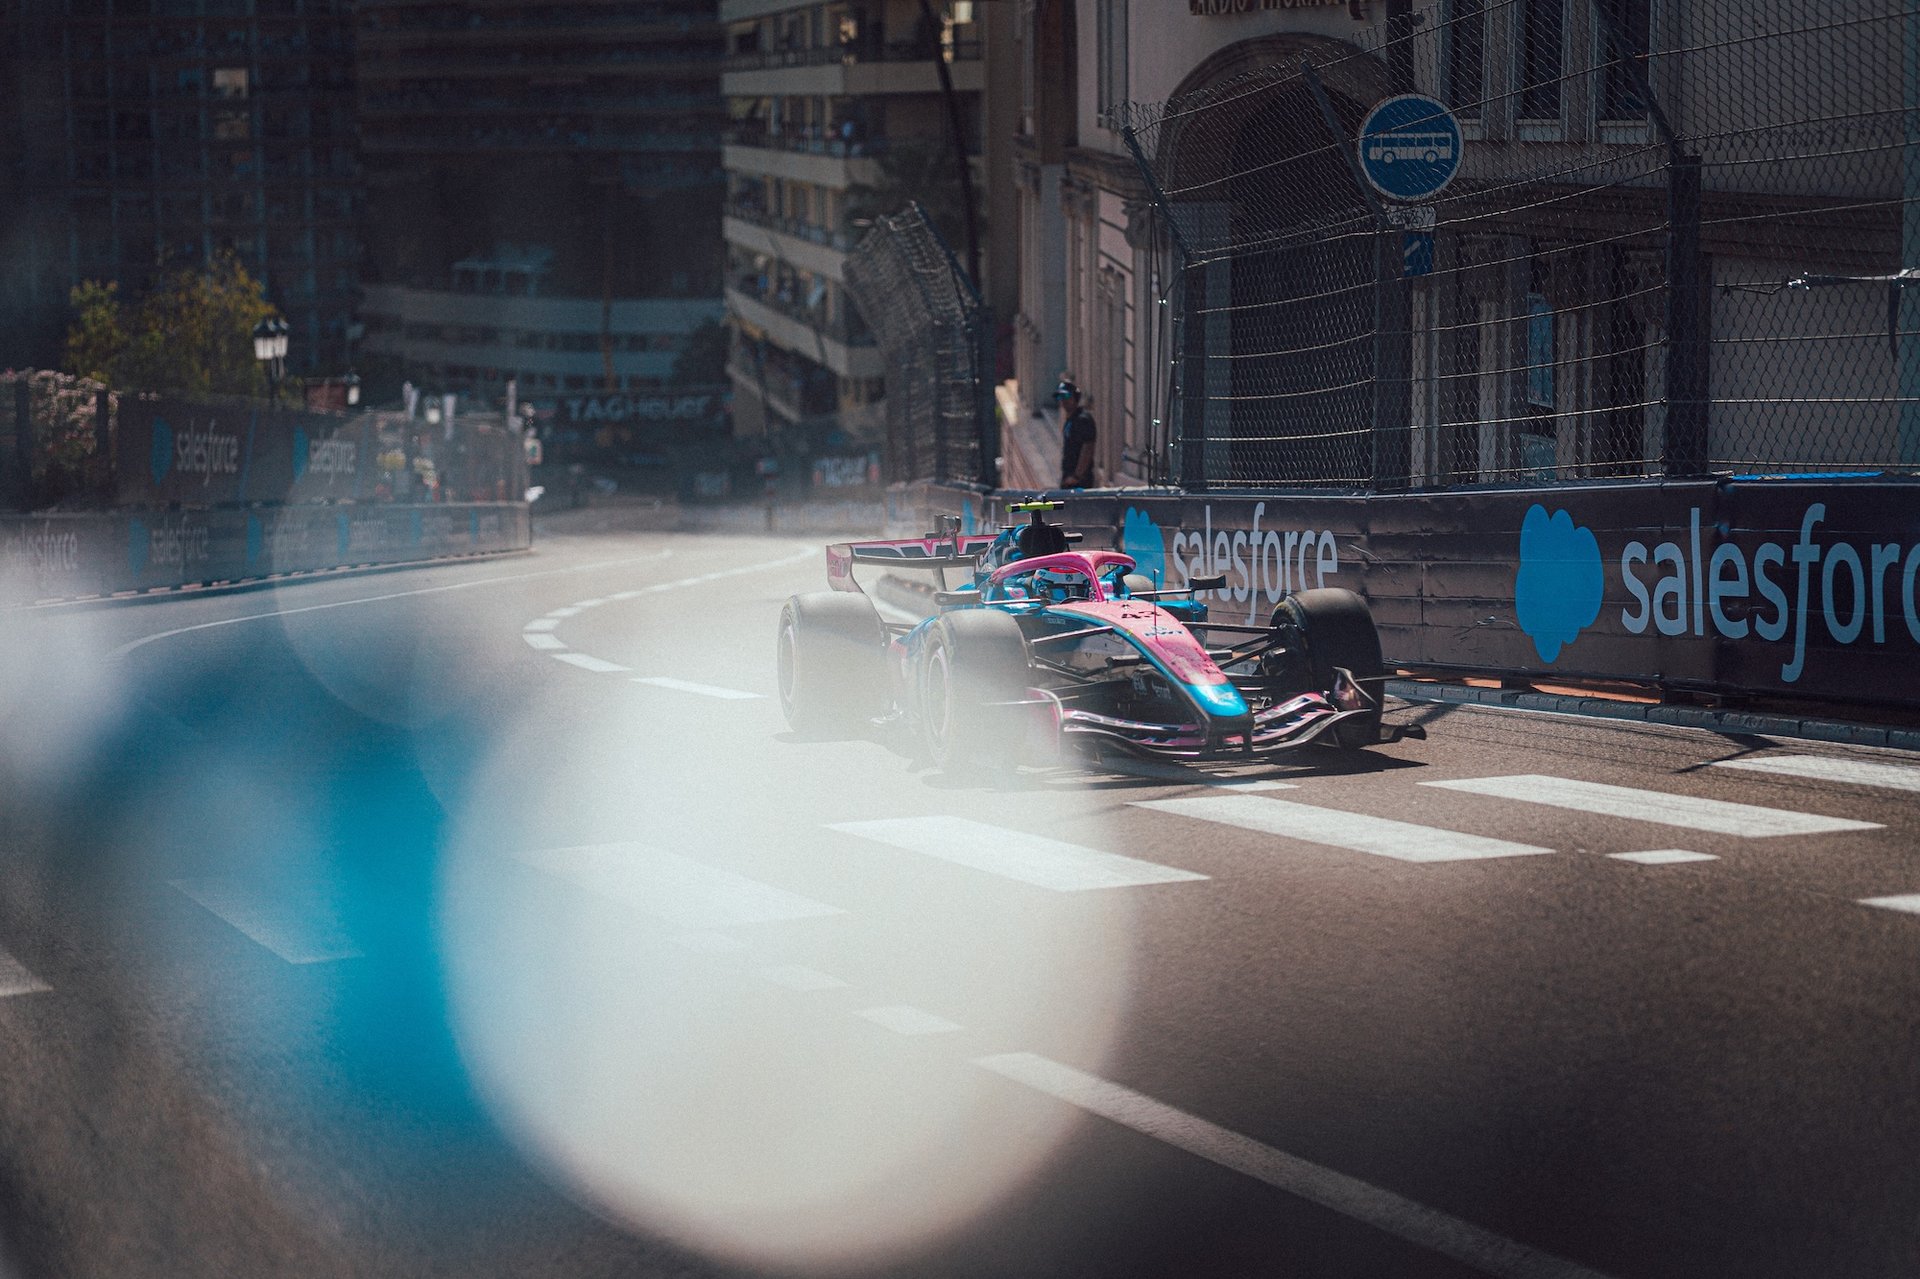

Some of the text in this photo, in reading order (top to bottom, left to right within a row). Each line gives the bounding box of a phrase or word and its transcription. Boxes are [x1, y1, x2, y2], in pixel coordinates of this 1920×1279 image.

[175, 418, 238, 487] salesforce
[309, 428, 355, 485] salesforce
[151, 514, 209, 576] salesforce
[1172, 503, 1338, 623] salesforce
